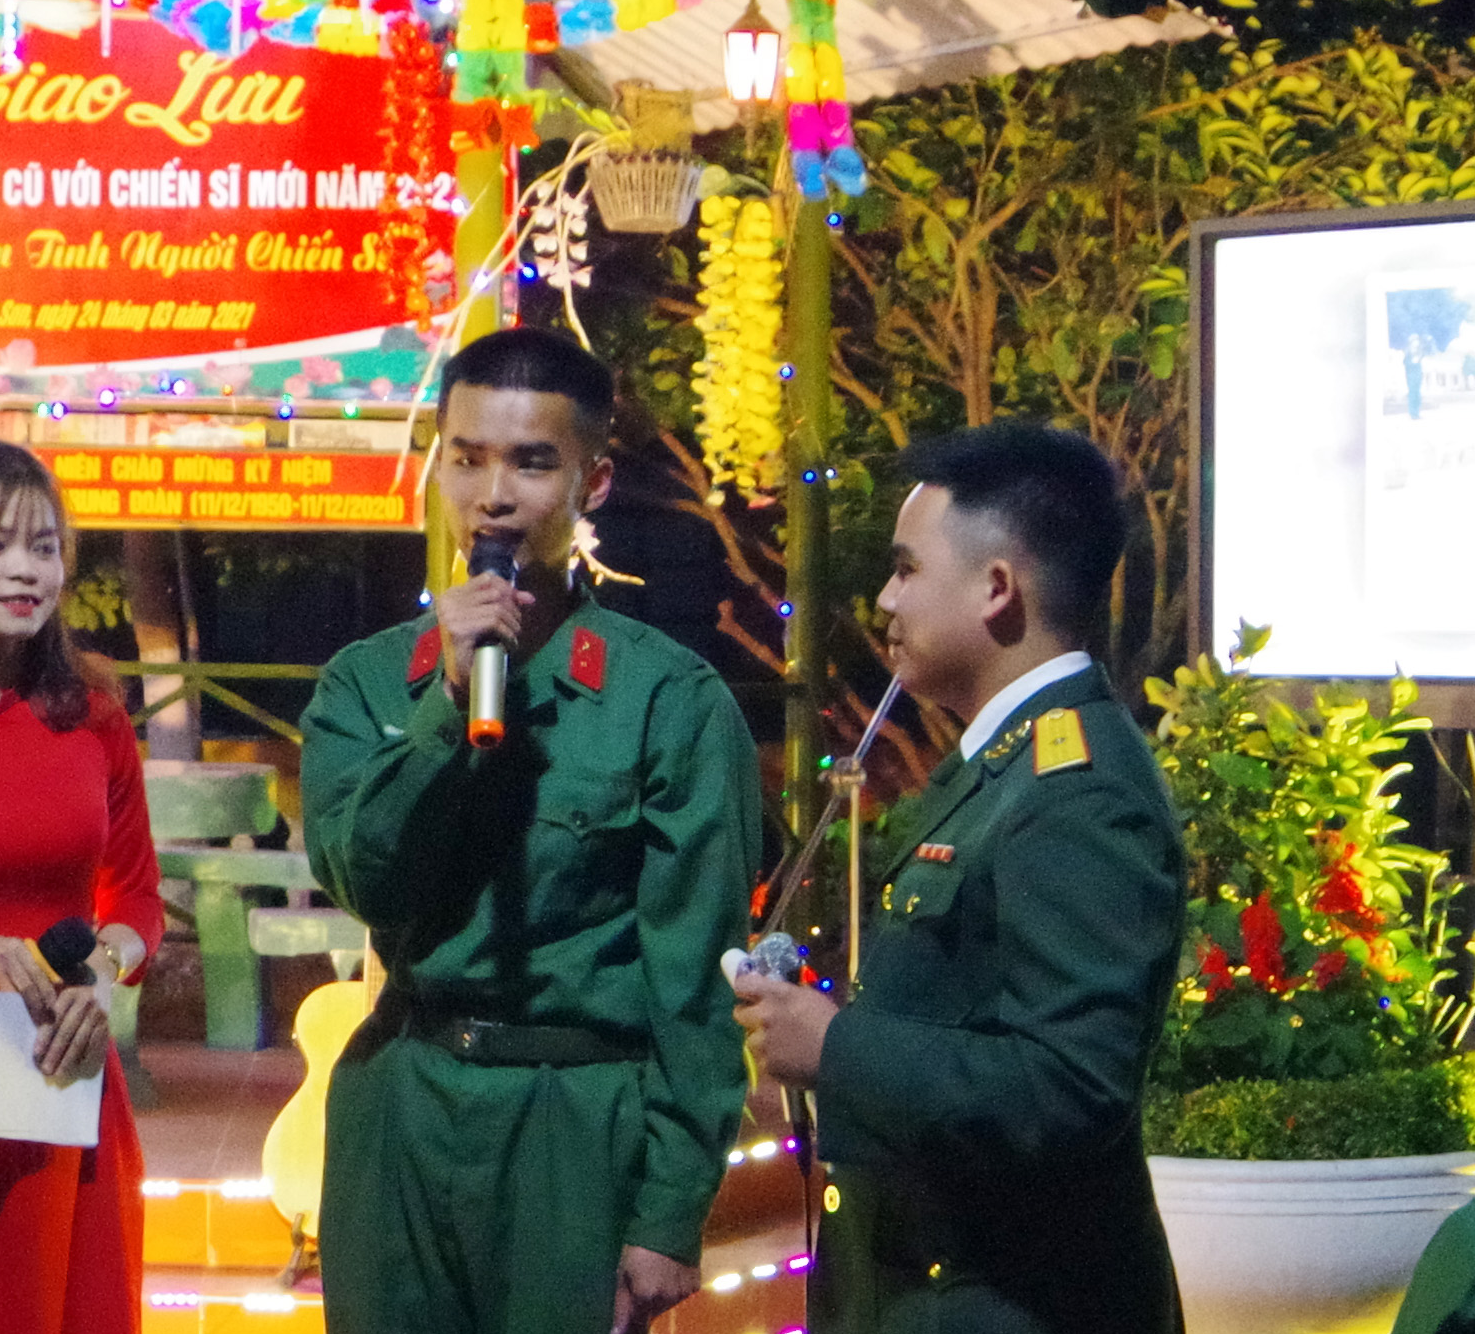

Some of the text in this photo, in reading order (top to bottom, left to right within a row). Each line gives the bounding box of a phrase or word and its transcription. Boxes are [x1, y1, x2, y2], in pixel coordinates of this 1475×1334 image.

[124, 50, 305, 146] Lưu
[2, 160, 45, 207] CŨ
[51, 158, 101, 207] VỚI
[108, 157, 201, 208] CHIẾN
[208, 163, 242, 208] SĨ
[247, 160, 307, 209] MỚI
[315, 163, 387, 210] NĂM
[121, 230, 239, 278] Người
[246, 229, 344, 271] Chiến
[75, 300, 102, 329] 24
[210, 301, 257, 331] 2021
[281, 454, 332, 487] NIỆM
[190, 491, 405, 521] (11/12/1950-11/12/2020)
